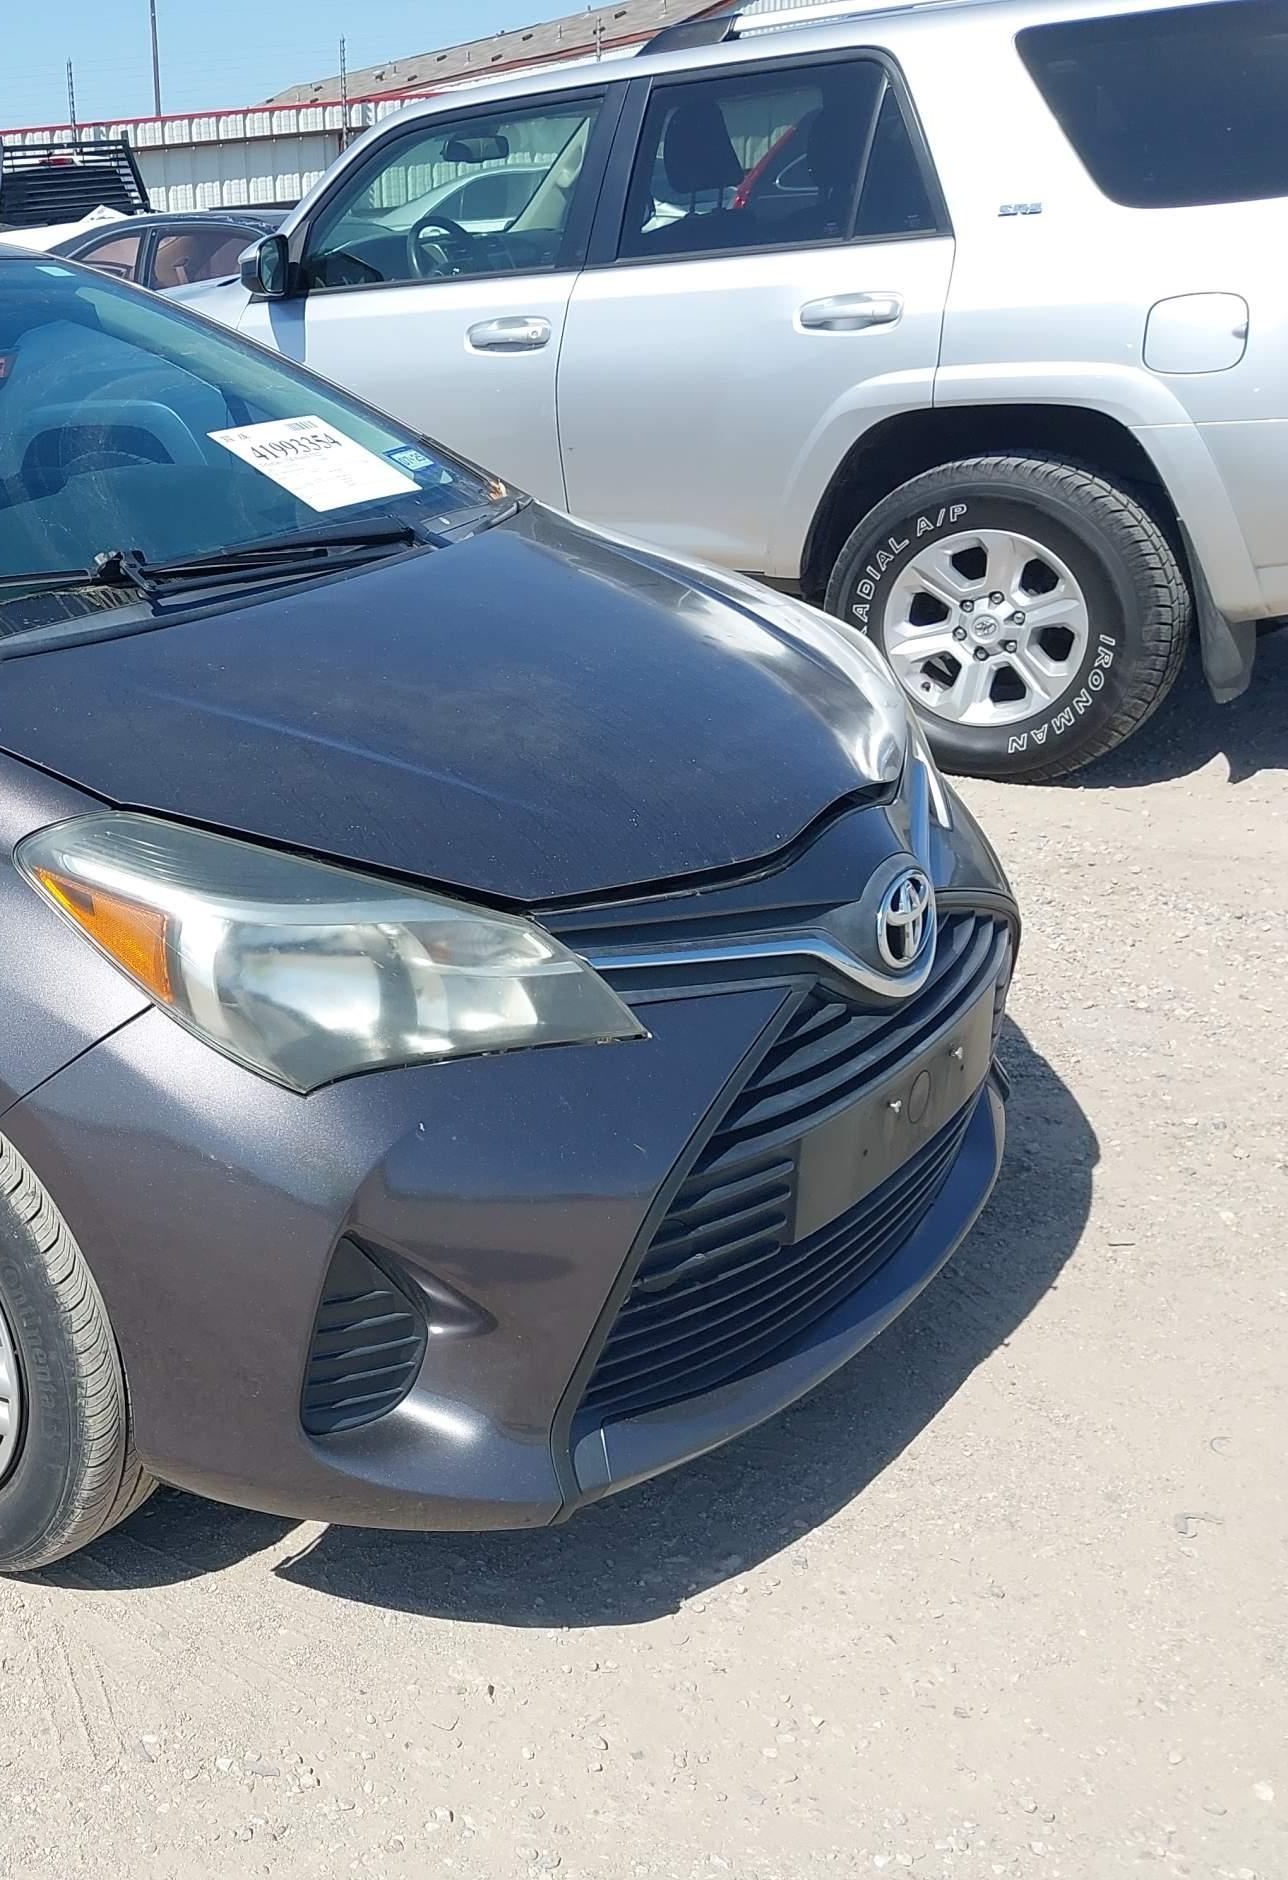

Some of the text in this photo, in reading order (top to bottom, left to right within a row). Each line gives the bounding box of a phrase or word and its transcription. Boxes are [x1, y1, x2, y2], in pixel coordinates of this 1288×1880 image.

[249, 432, 343, 461] 41993354
[852, 503, 968, 634] ADIAL A/P
[1007, 632, 1116, 754] IRONMAN
